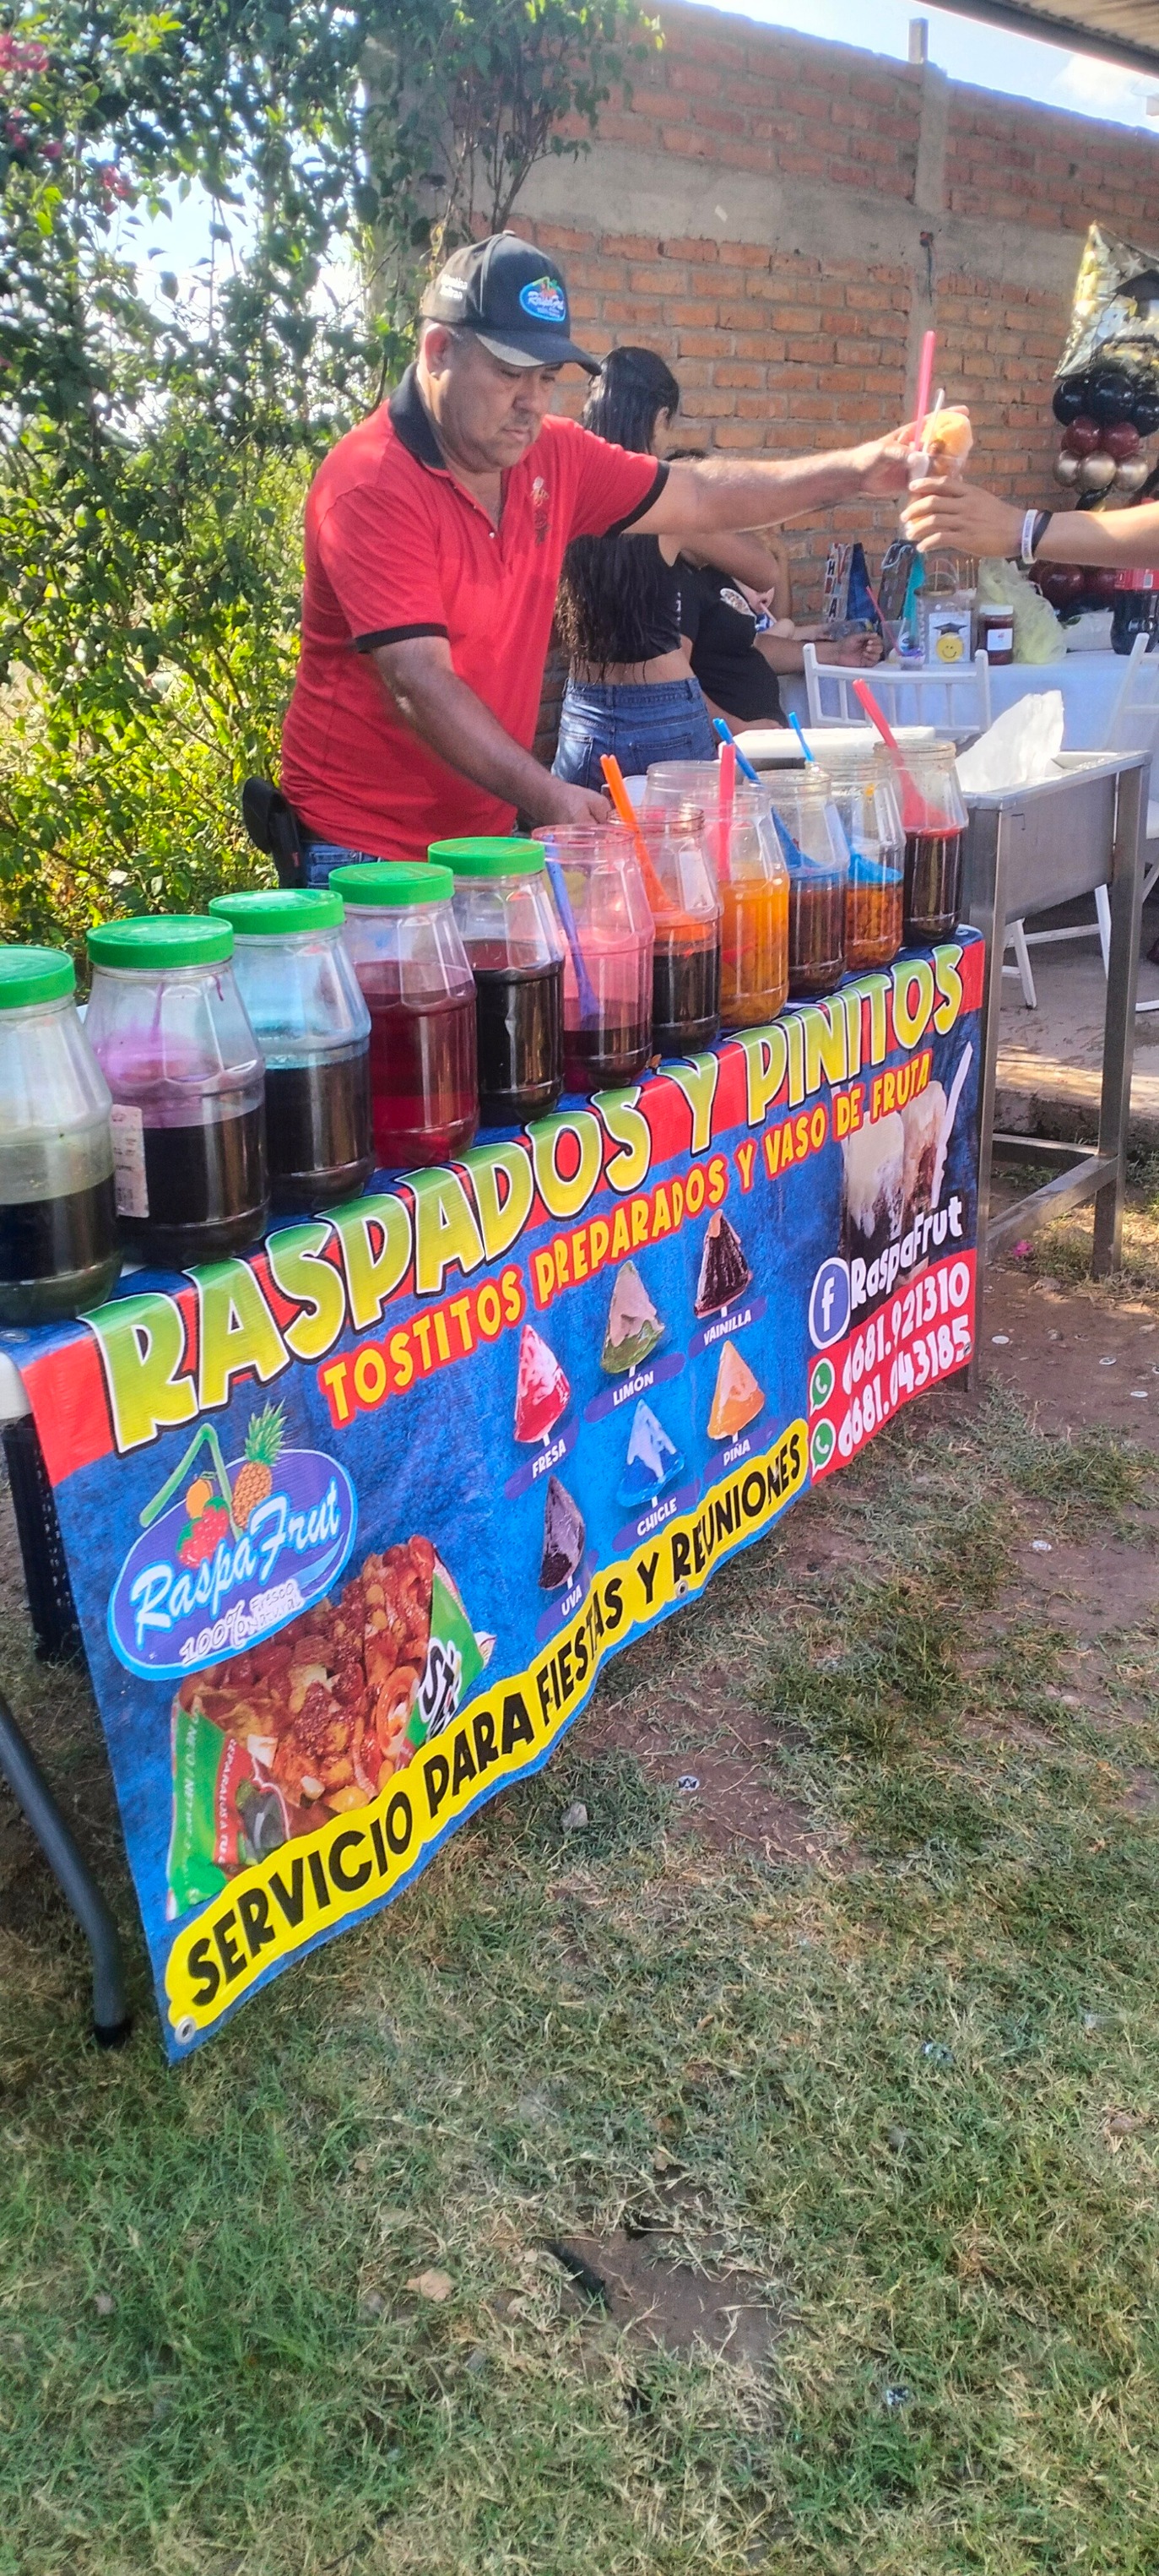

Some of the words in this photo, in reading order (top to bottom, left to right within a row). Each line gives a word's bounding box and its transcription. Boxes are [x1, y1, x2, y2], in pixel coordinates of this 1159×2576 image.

[78, 1086, 651, 1454] RASPADOS
[658, 1053, 719, 1155] Y
[723, 942, 964, 1127] PINITOS
[323, 1272, 522, 1422] TOSTITOS
[534, 1158, 726, 1304] PREPARADOS
[736, 1145, 756, 1189] Y
[765, 1107, 825, 1174] VASO
[837, 1093, 861, 1133] DE
[872, 1050, 930, 1119] FRUTA
[852, 1196, 963, 1310] RaspaFrut
[703, 1310, 752, 1346] VAINILLA
[613, 1370, 654, 1407] LIMÓN
[837, 1314, 972, 1456] 6681.043185
[532, 1440, 566, 1479] FRESA
[723, 1439, 750, 1467] PIÑA
[636, 1497, 677, 1537] CHICLE
[131, 1476, 339, 1651] RaspaFrut
[252, 1581, 295, 1612] Fresco
[561, 1584, 582, 1616] UVA
[180, 1602, 250, 1665] 100%
[187, 1792, 414, 2008] SERVICIO
[425, 1693, 534, 1814] PARA
[536, 1577, 623, 1728] FIESTAS
[636, 1552, 660, 1605] Y
[670, 1434, 801, 1584] REUNIONES
